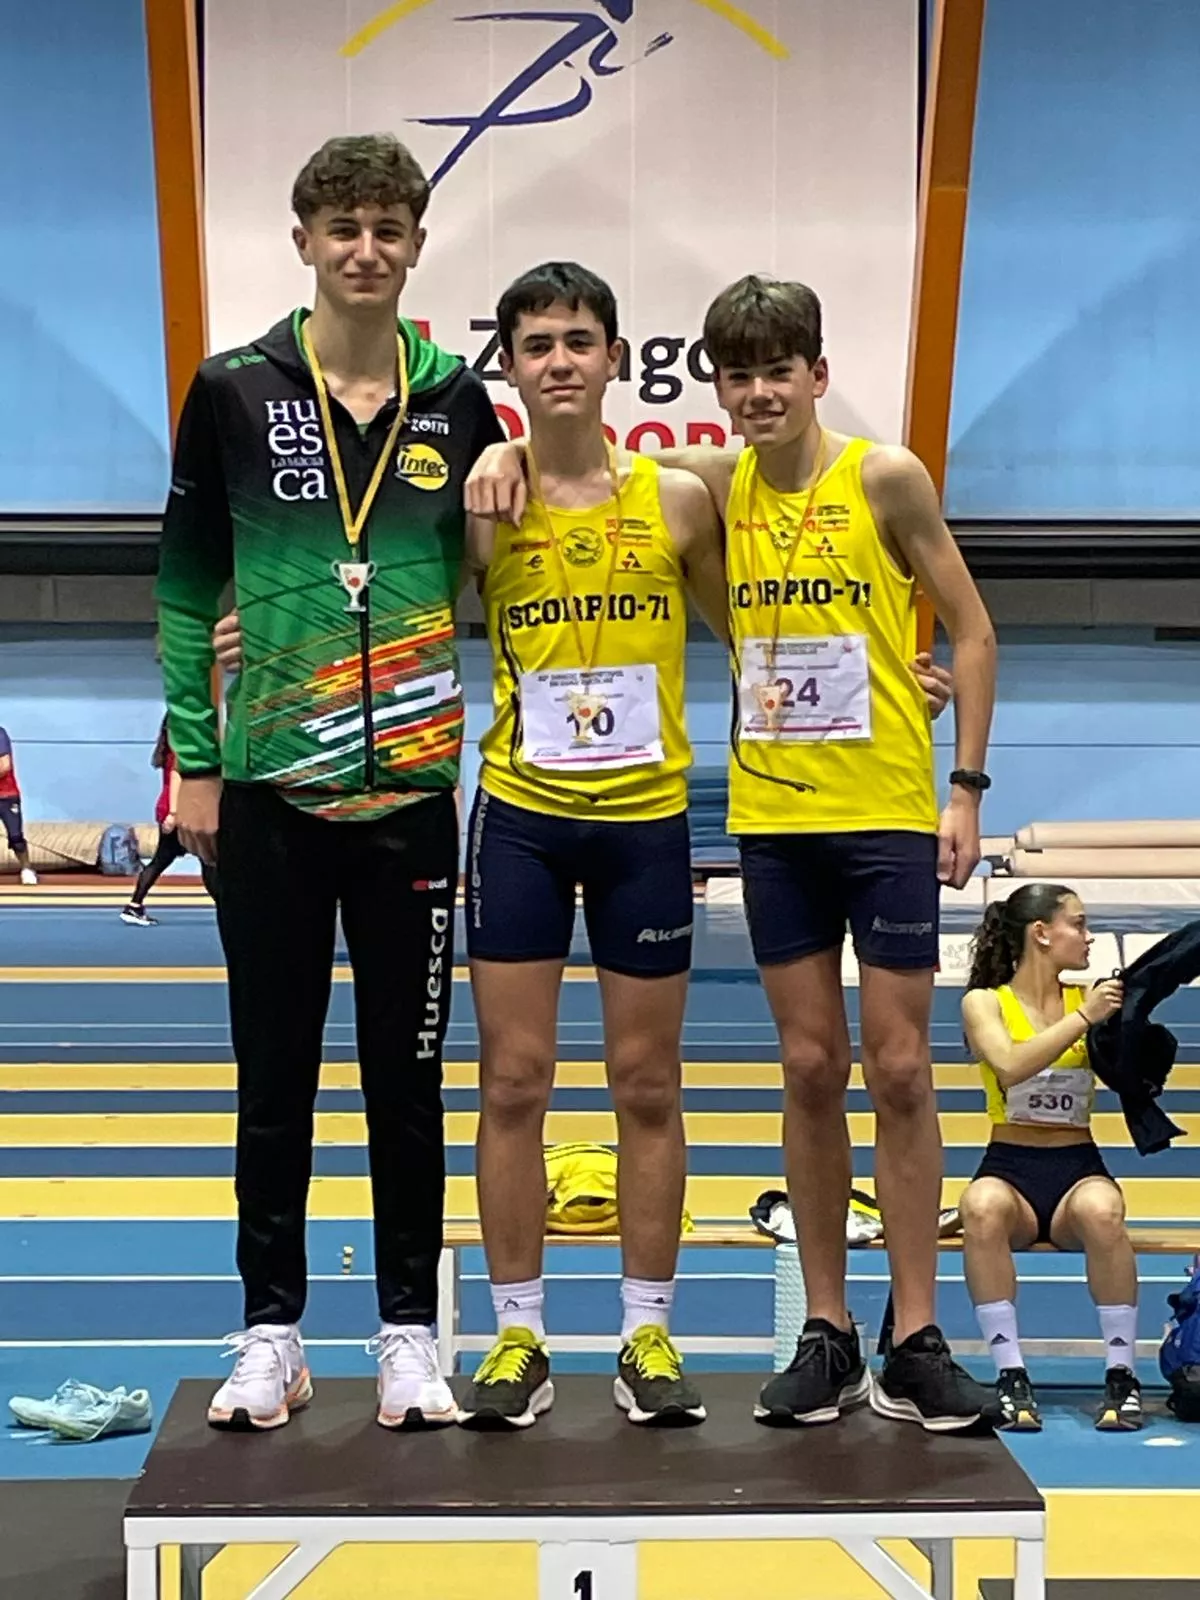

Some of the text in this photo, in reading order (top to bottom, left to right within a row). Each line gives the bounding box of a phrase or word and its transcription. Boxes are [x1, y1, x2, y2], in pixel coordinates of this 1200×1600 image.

[268, 423, 323, 455] es
[273, 467, 328, 500] ca
[507, 594, 670, 629] SCORPIO-71
[416, 907, 449, 1060] Huesca
[1028, 1093, 1073, 1111] 530
[573, 1570, 592, 1600] 1
